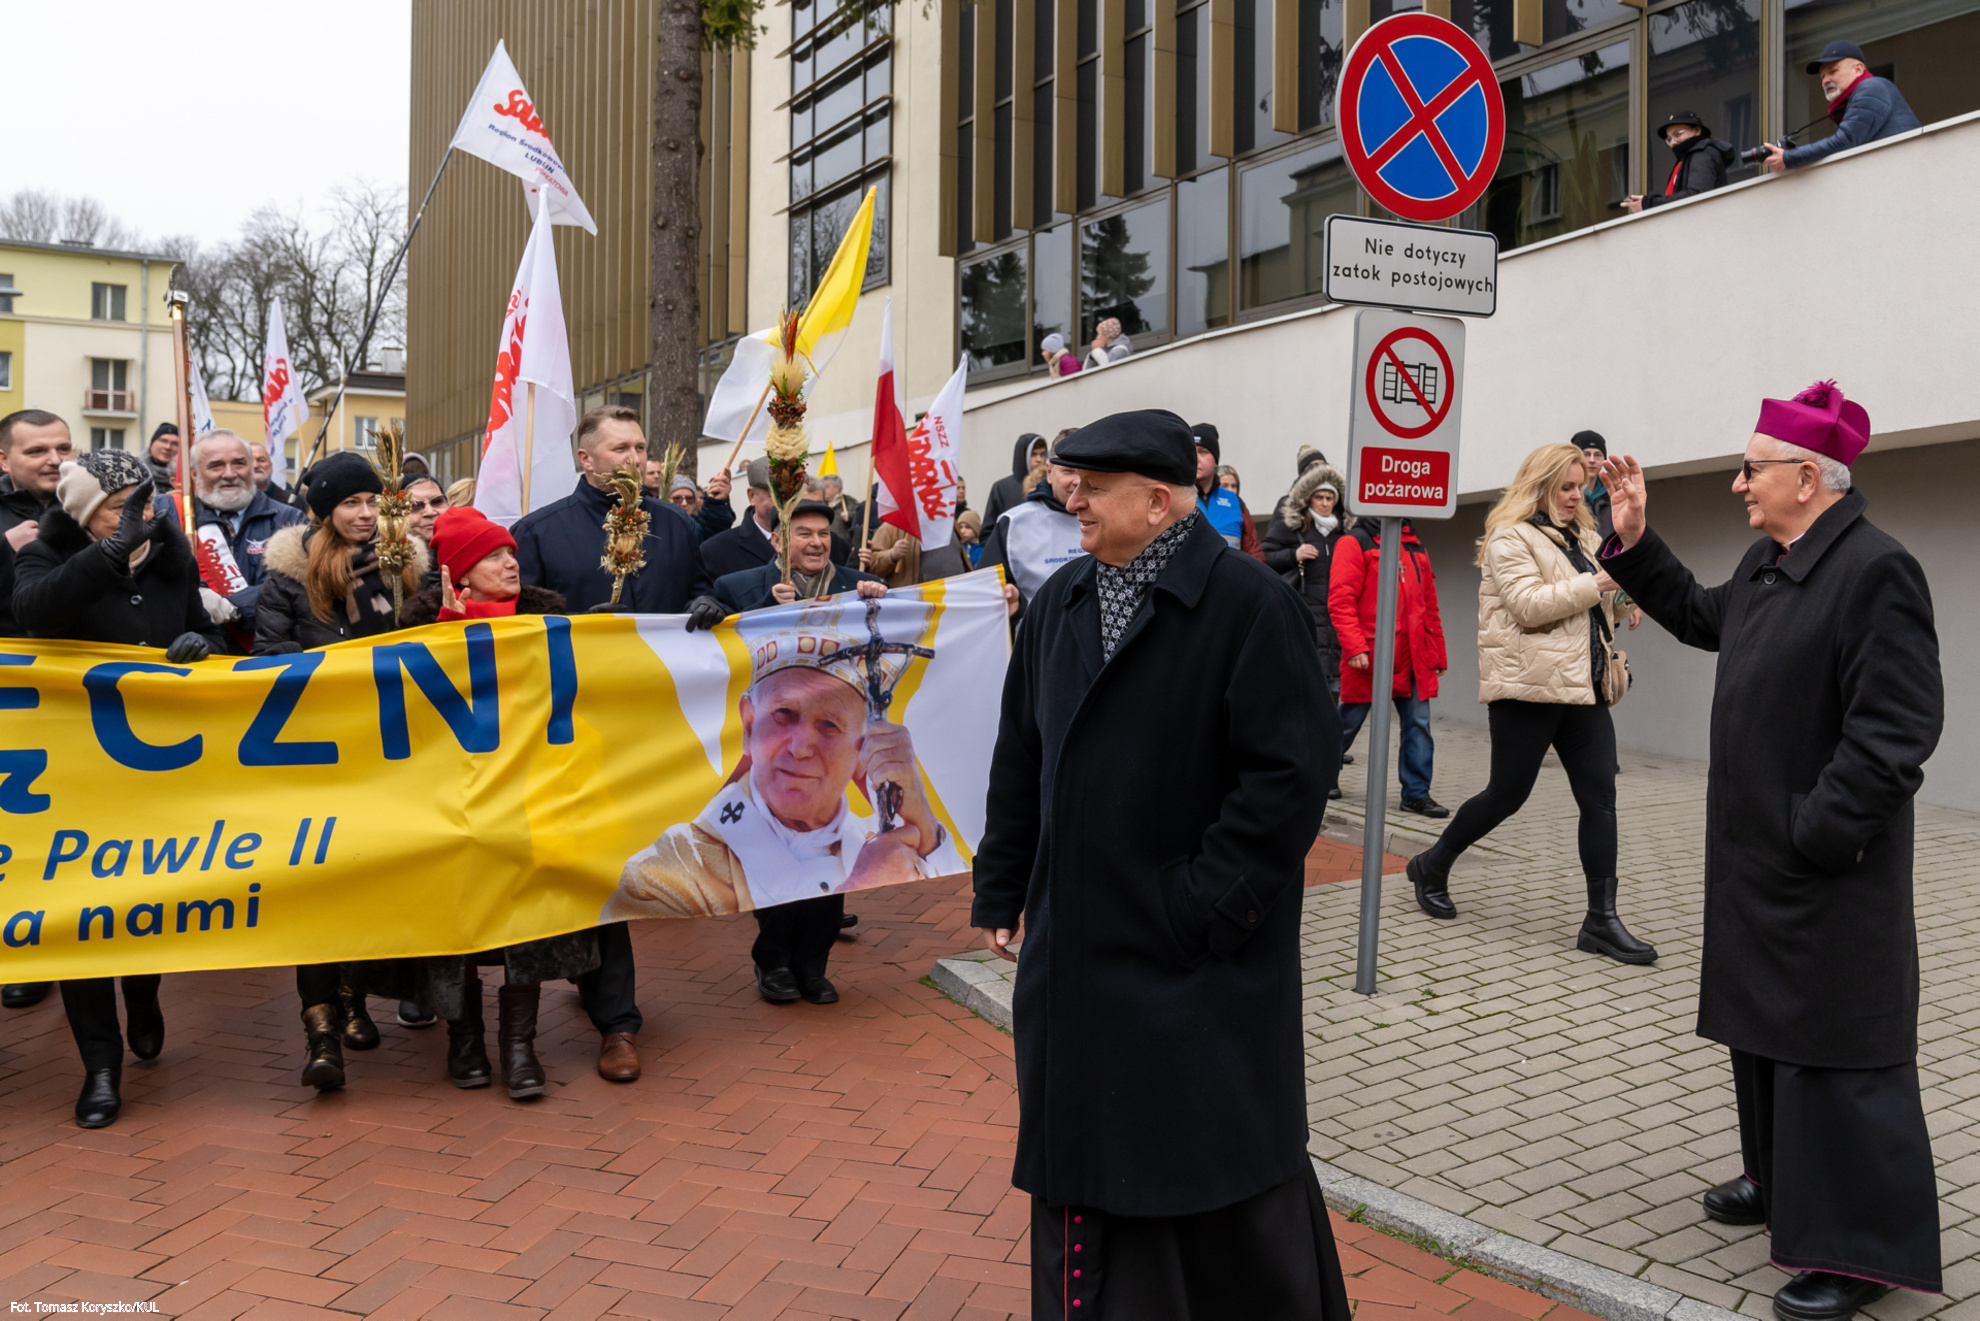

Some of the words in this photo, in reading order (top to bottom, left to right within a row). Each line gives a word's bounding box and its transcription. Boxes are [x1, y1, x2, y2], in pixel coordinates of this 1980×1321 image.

[488, 123, 517, 142] Region
[525, 152, 555, 174] LUBLIN
[1365, 238, 1394, 256] Nie
[1404, 243, 1466, 269] dotyczy
[1333, 262, 1381, 281] zatok
[1391, 270, 1493, 295] postojowych
[934, 415, 949, 448] NSZZ
[1381, 455, 1431, 479] Droga
[1364, 480, 1443, 500] pożarowa
[1068, 547, 1086, 555] REG
[42, 819, 263, 881] Pawle
[288, 816, 337, 866] II
[77, 883, 261, 942] nami
